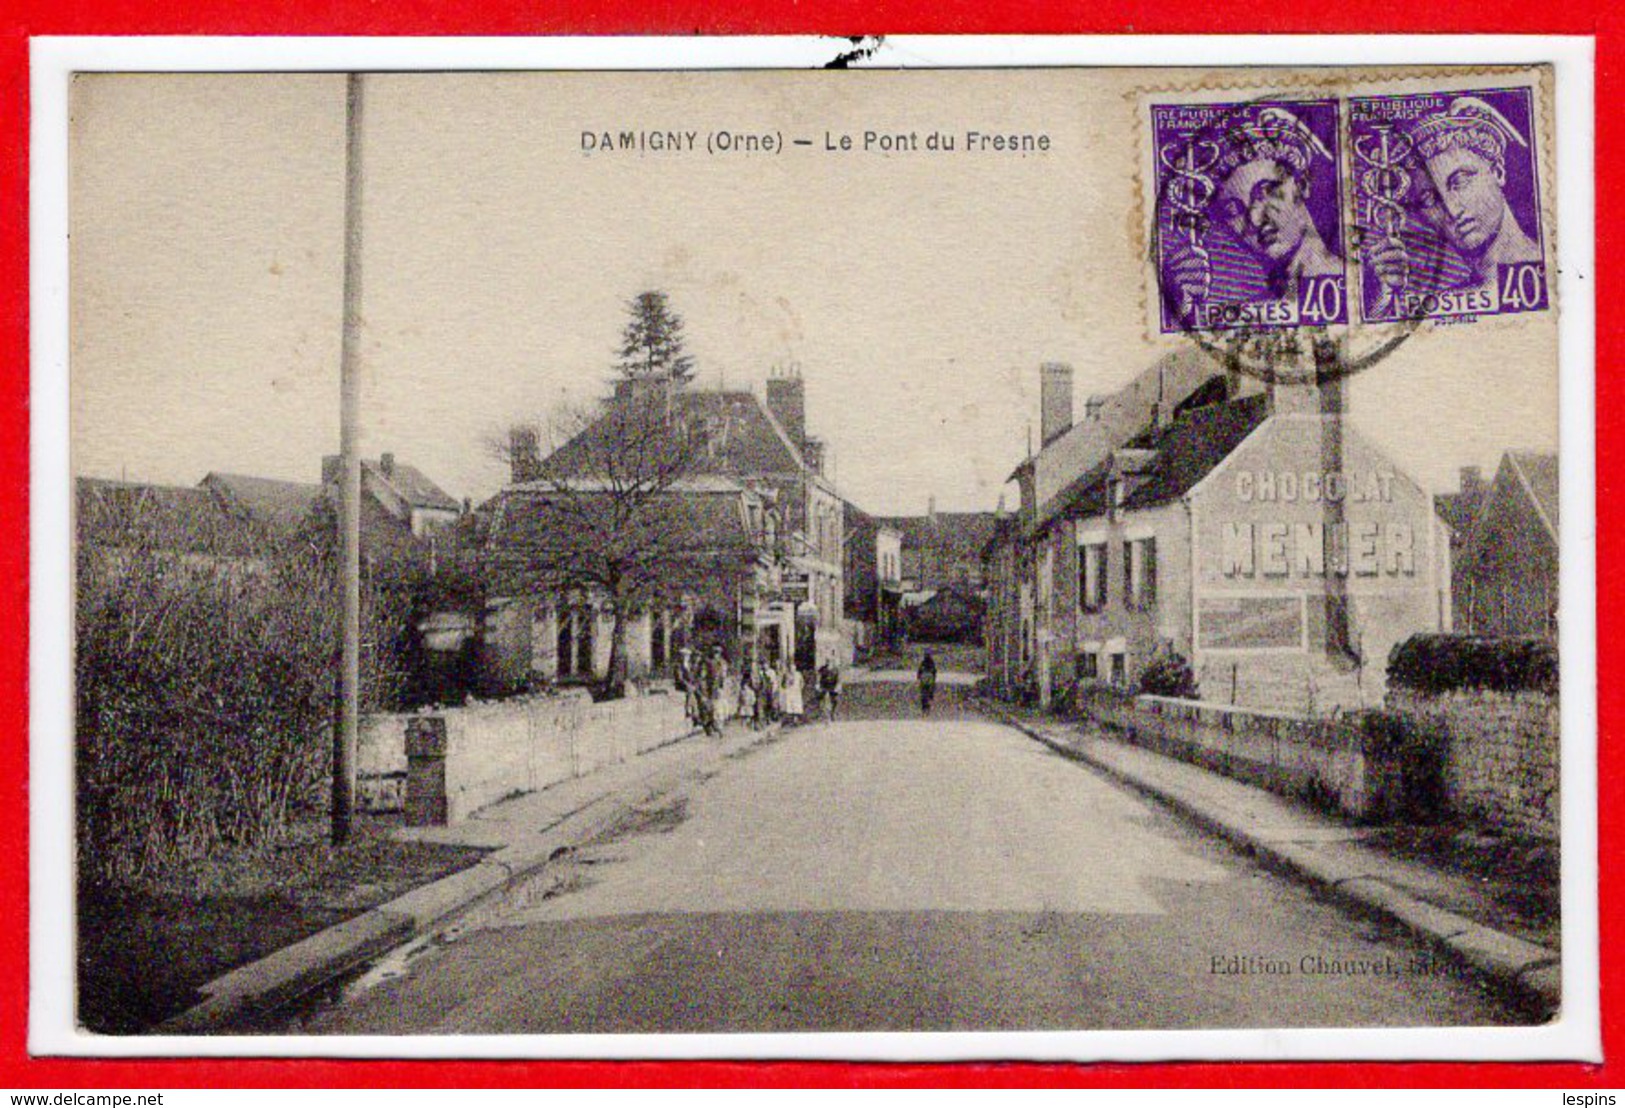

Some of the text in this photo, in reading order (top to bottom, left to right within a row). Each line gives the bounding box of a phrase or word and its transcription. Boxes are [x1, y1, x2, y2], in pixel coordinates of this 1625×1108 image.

[581, 131, 697, 150] DAMIGNY
[706, 131, 783, 154] (Orne)
[825, 131, 852, 151] Le
[864, 131, 918, 151] Pont
[926, 131, 954, 151] du
[967, 131, 1051, 151] Fresne
[1208, 301, 1292, 324] POSTES
[1408, 290, 1492, 314] POSTES
[1236, 472, 1395, 501] CHOCOLAT
[1222, 523, 1415, 578] MENIER
[1210, 955, 1291, 975] Edition
